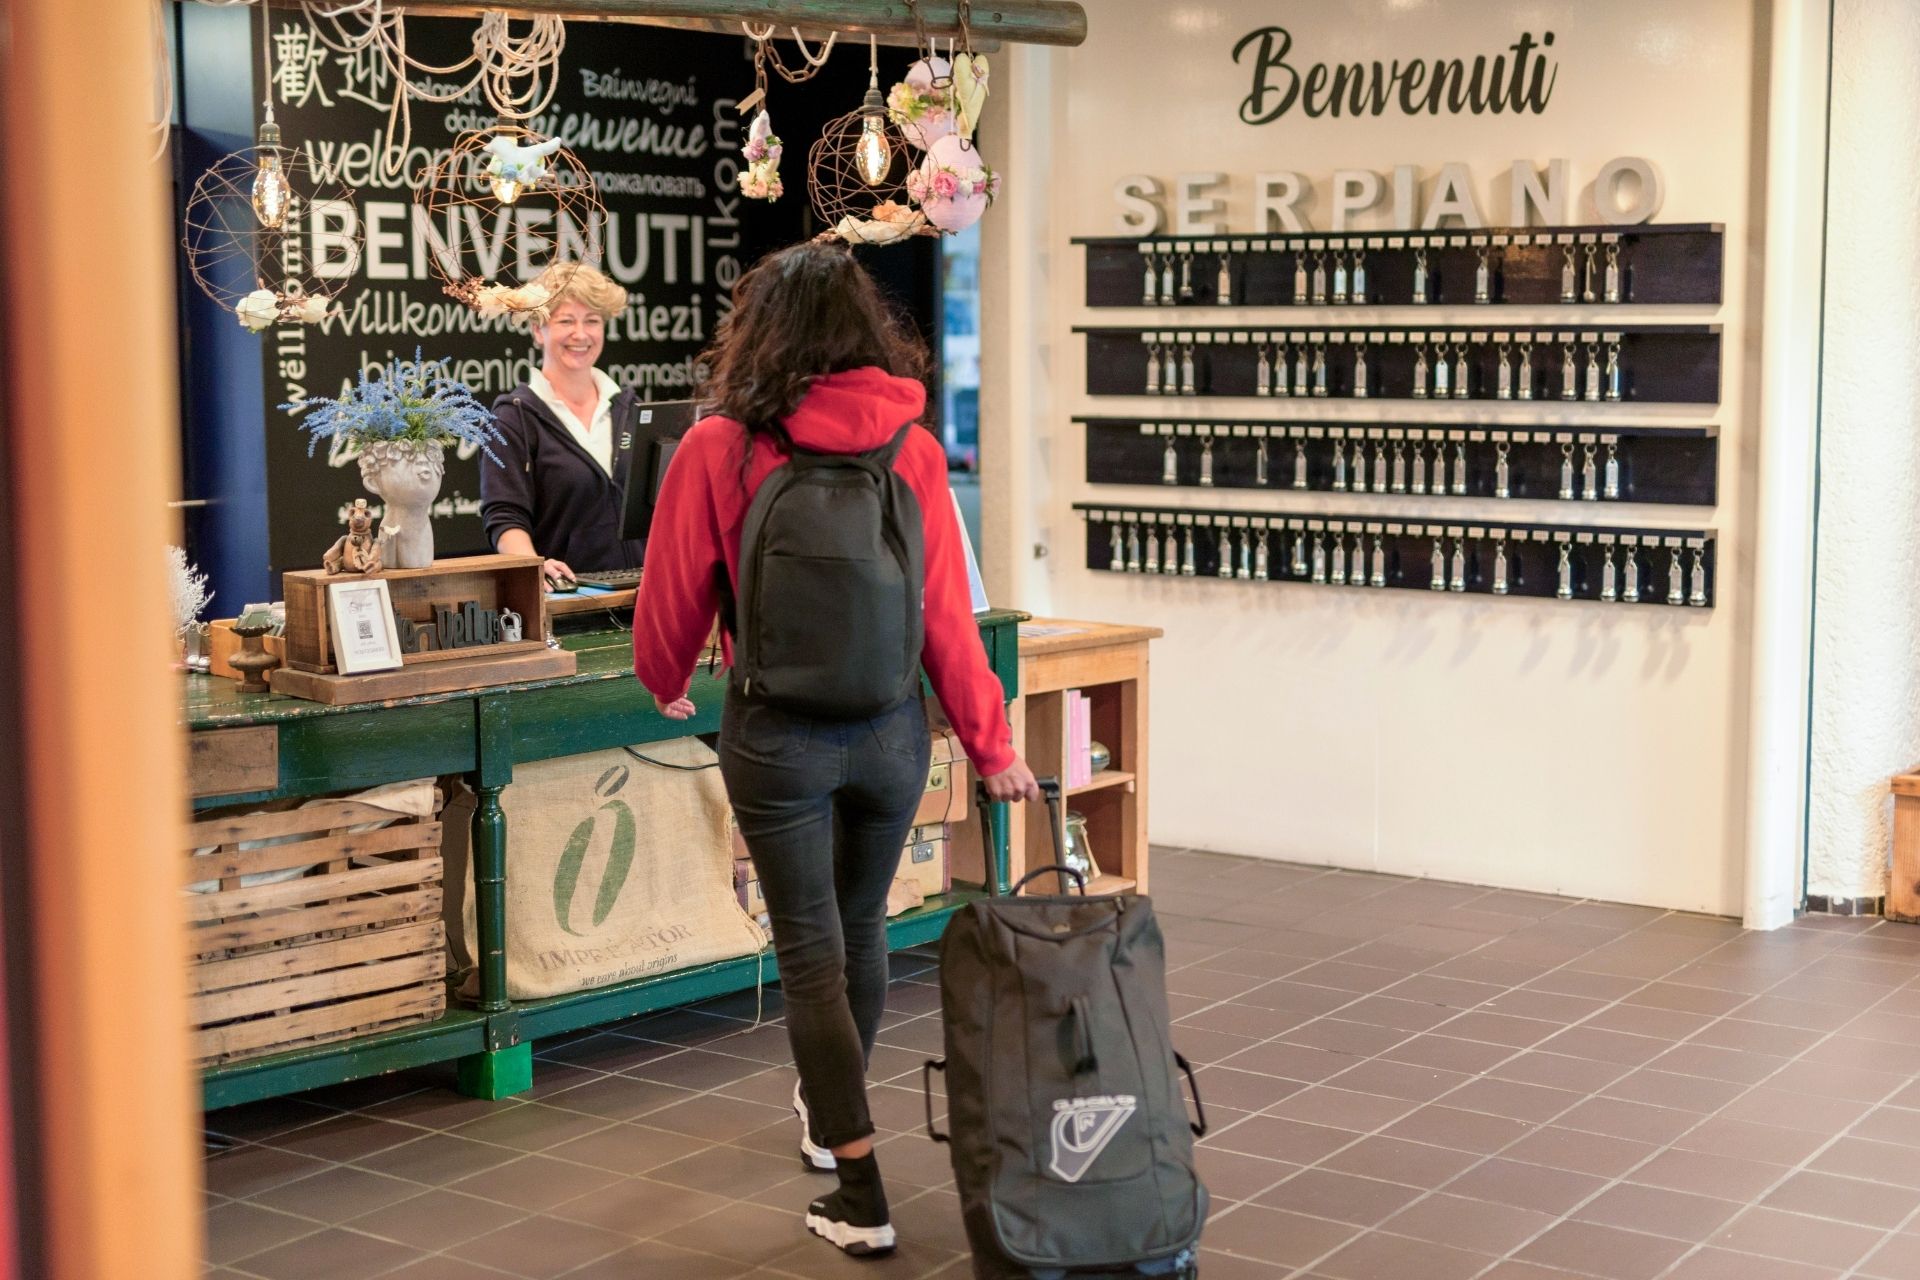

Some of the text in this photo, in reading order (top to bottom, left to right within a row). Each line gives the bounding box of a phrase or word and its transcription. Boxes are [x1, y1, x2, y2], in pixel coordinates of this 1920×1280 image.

[272, 22, 392, 112] 歡迎
[579, 67, 698, 115] Bainvegni
[1232, 26, 1558, 125] Benvenuti
[305, 128, 493, 194] welcome
[526, 80, 708, 158] bienvenue
[1111, 156, 1664, 238] SERPIANO
[310, 199, 704, 285] BENVENUTI
[276, 196, 307, 417] wëllomm
